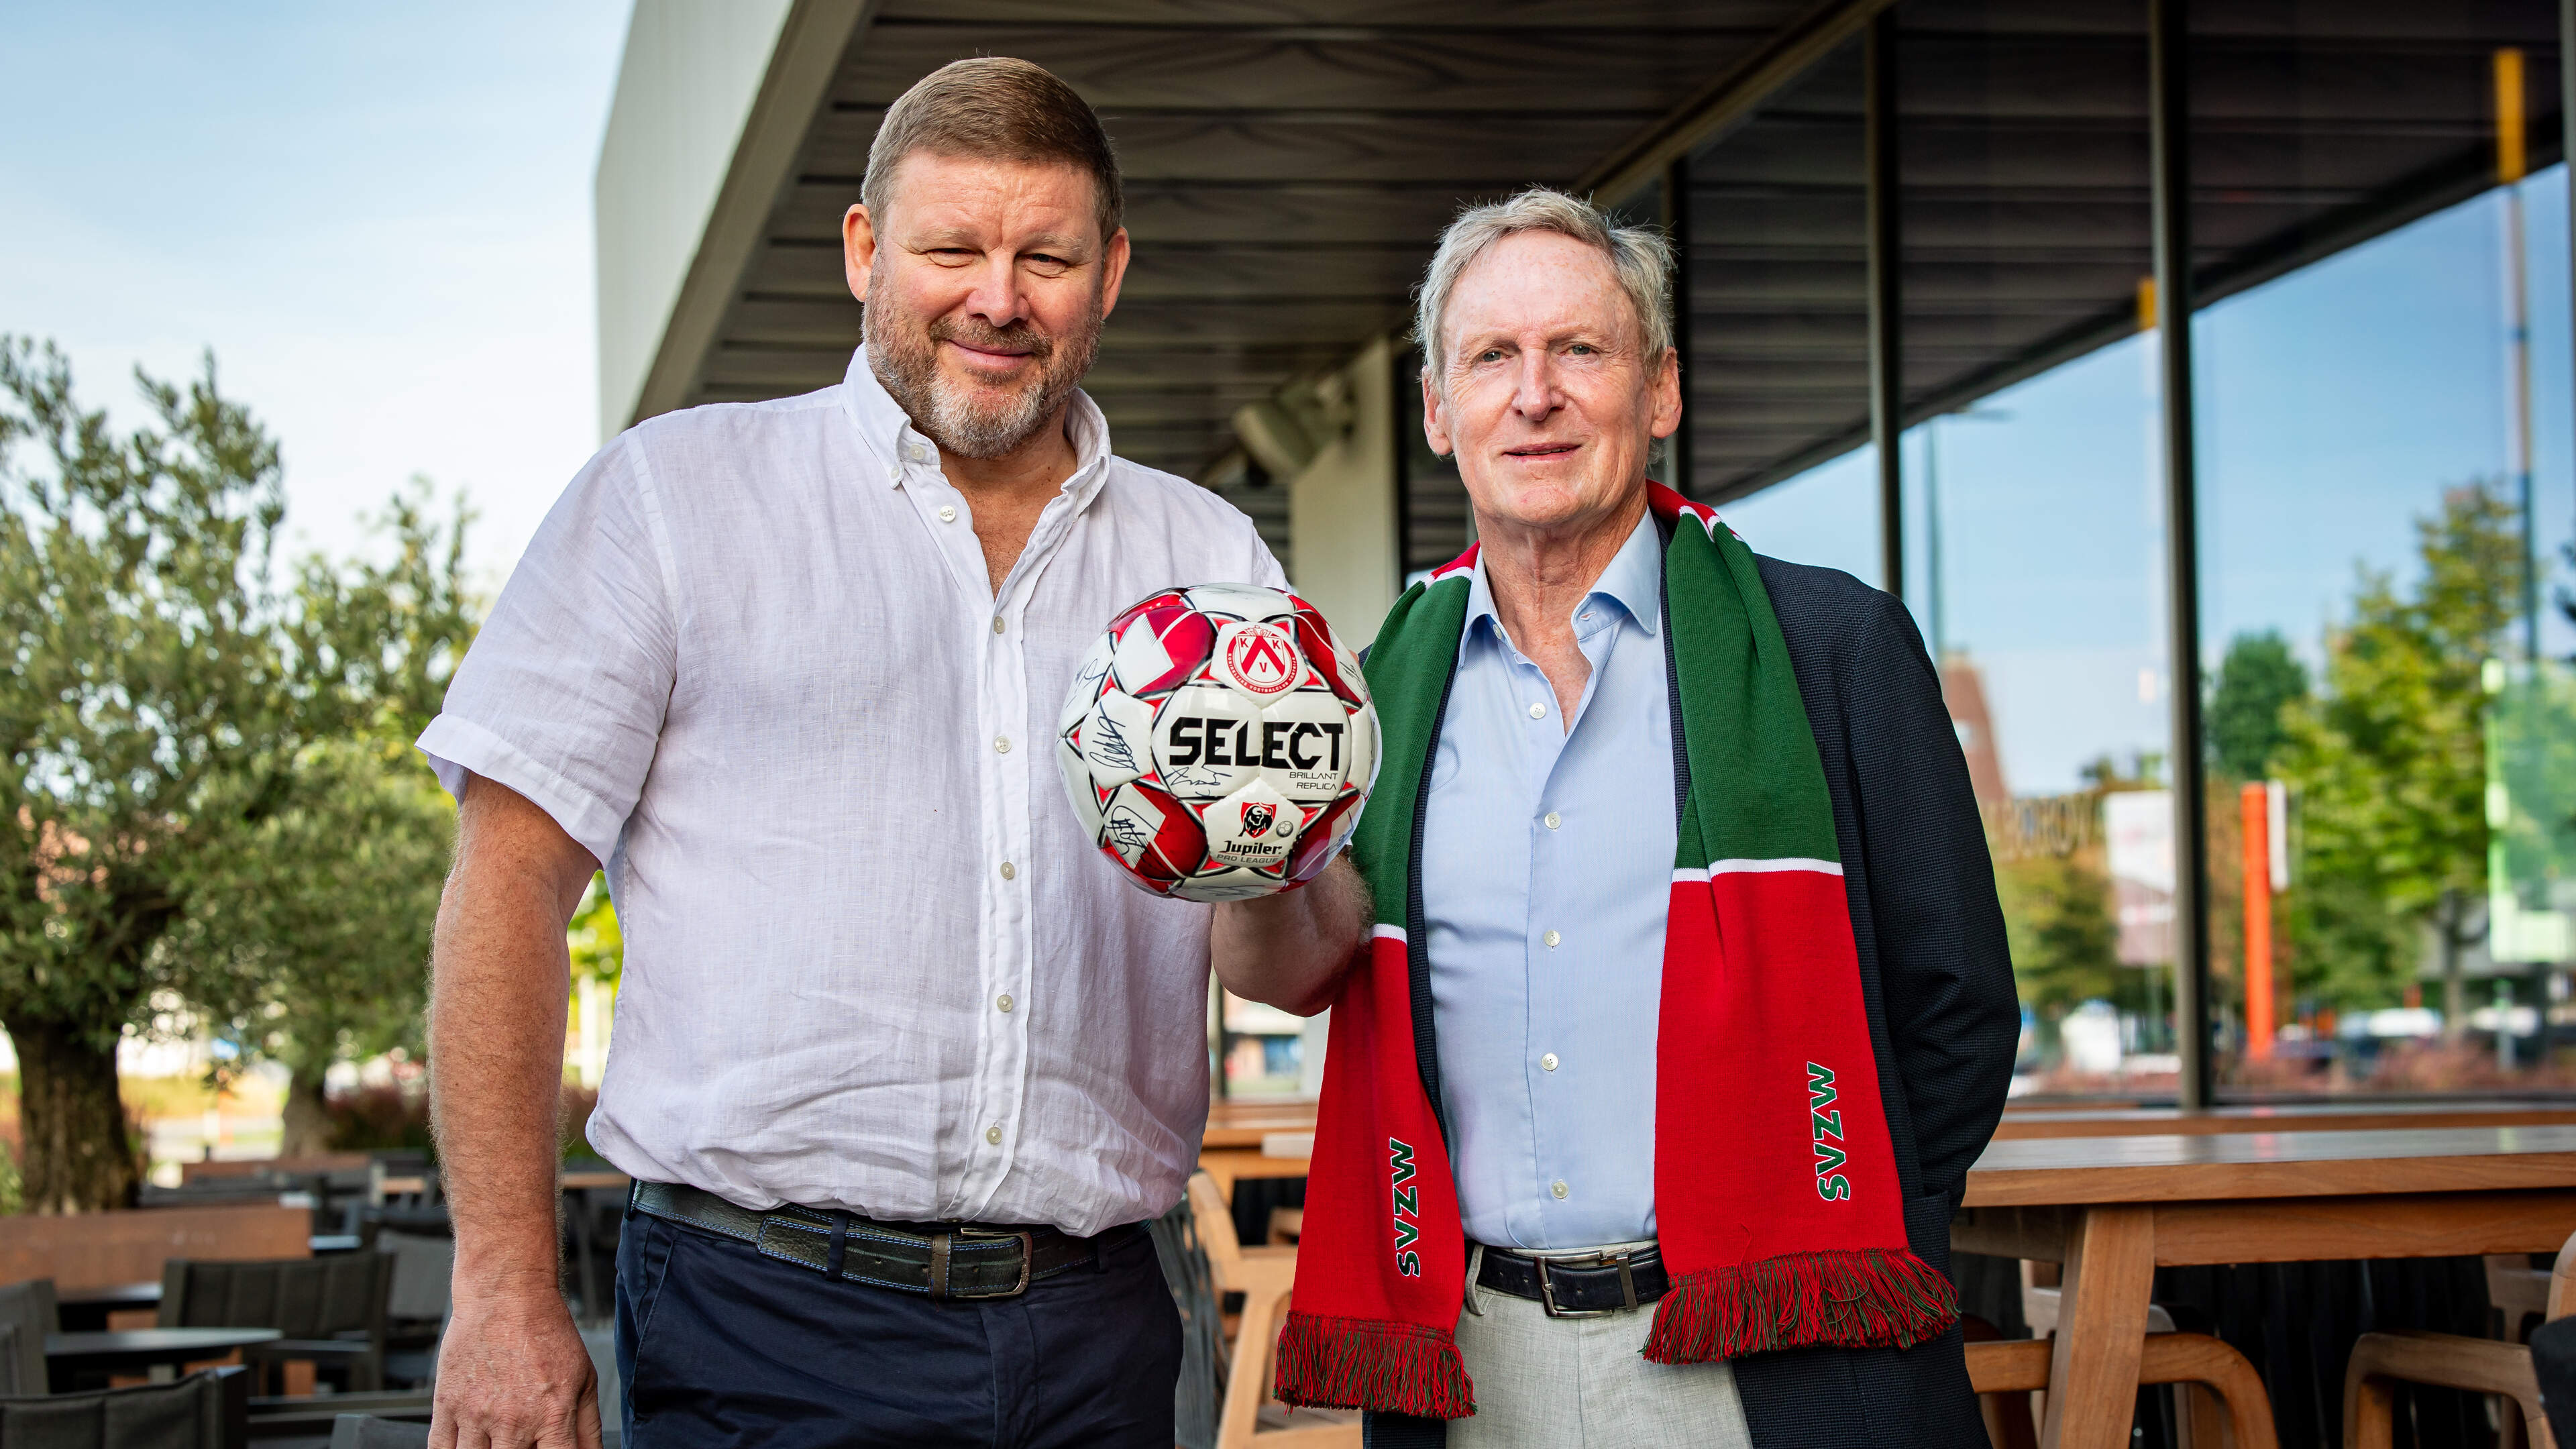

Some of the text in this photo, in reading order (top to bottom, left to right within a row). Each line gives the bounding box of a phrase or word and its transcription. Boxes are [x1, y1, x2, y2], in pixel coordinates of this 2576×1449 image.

[1240, 637, 1248, 647] K
[1272, 639, 1281, 649] K
[1259, 662, 1267, 673] V
[1169, 716, 1344, 771] SELECT
[1289, 771, 1338, 780] BRILLANT
[1296, 782, 1337, 790] REPLICA
[1218, 840, 1283, 856] Jupiler
[1806, 1061, 1851, 1202] SVZW
[1389, 1136, 1421, 1278] SVZW
